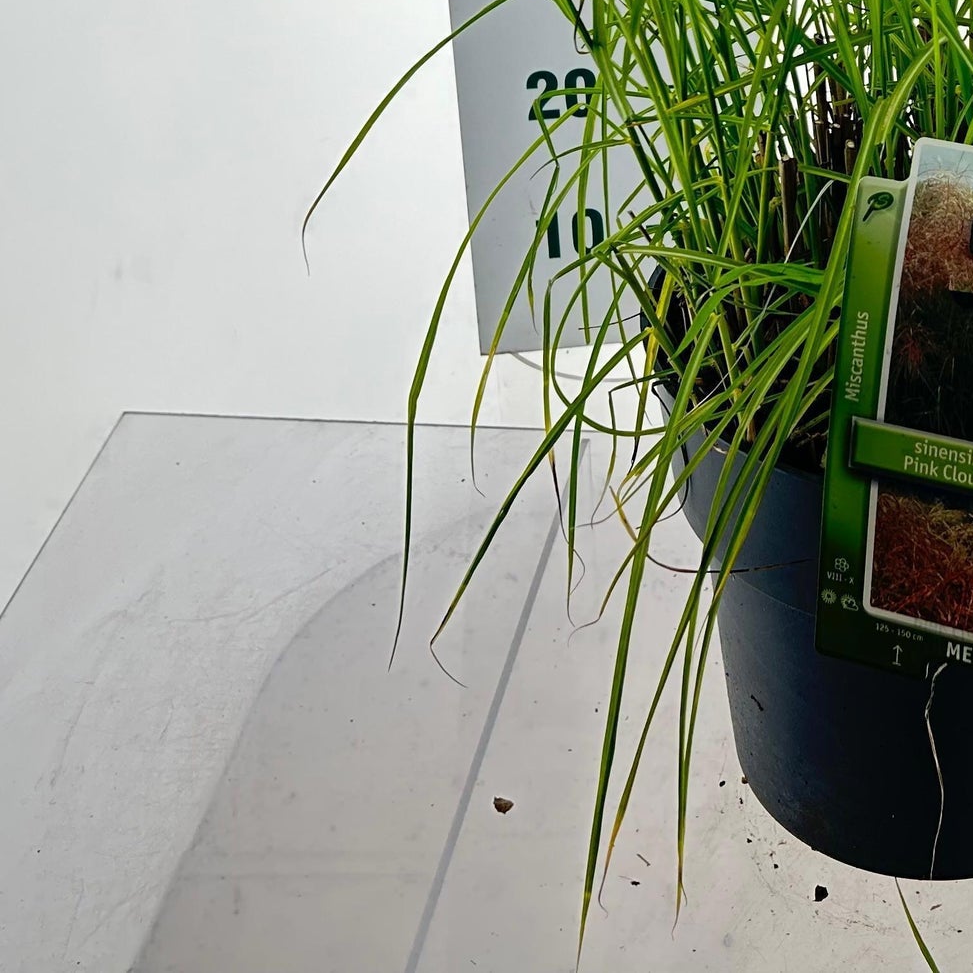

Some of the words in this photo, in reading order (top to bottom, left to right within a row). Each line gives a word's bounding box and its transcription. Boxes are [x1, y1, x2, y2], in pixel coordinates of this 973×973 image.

[526, 68, 596, 121] 20
[536, 208, 604, 259] 10
[844, 310, 870, 403] Miscanthus
[904, 455, 939, 478] Pink
[875, 622, 890, 633] 125
[897, 628, 911, 639] 150
